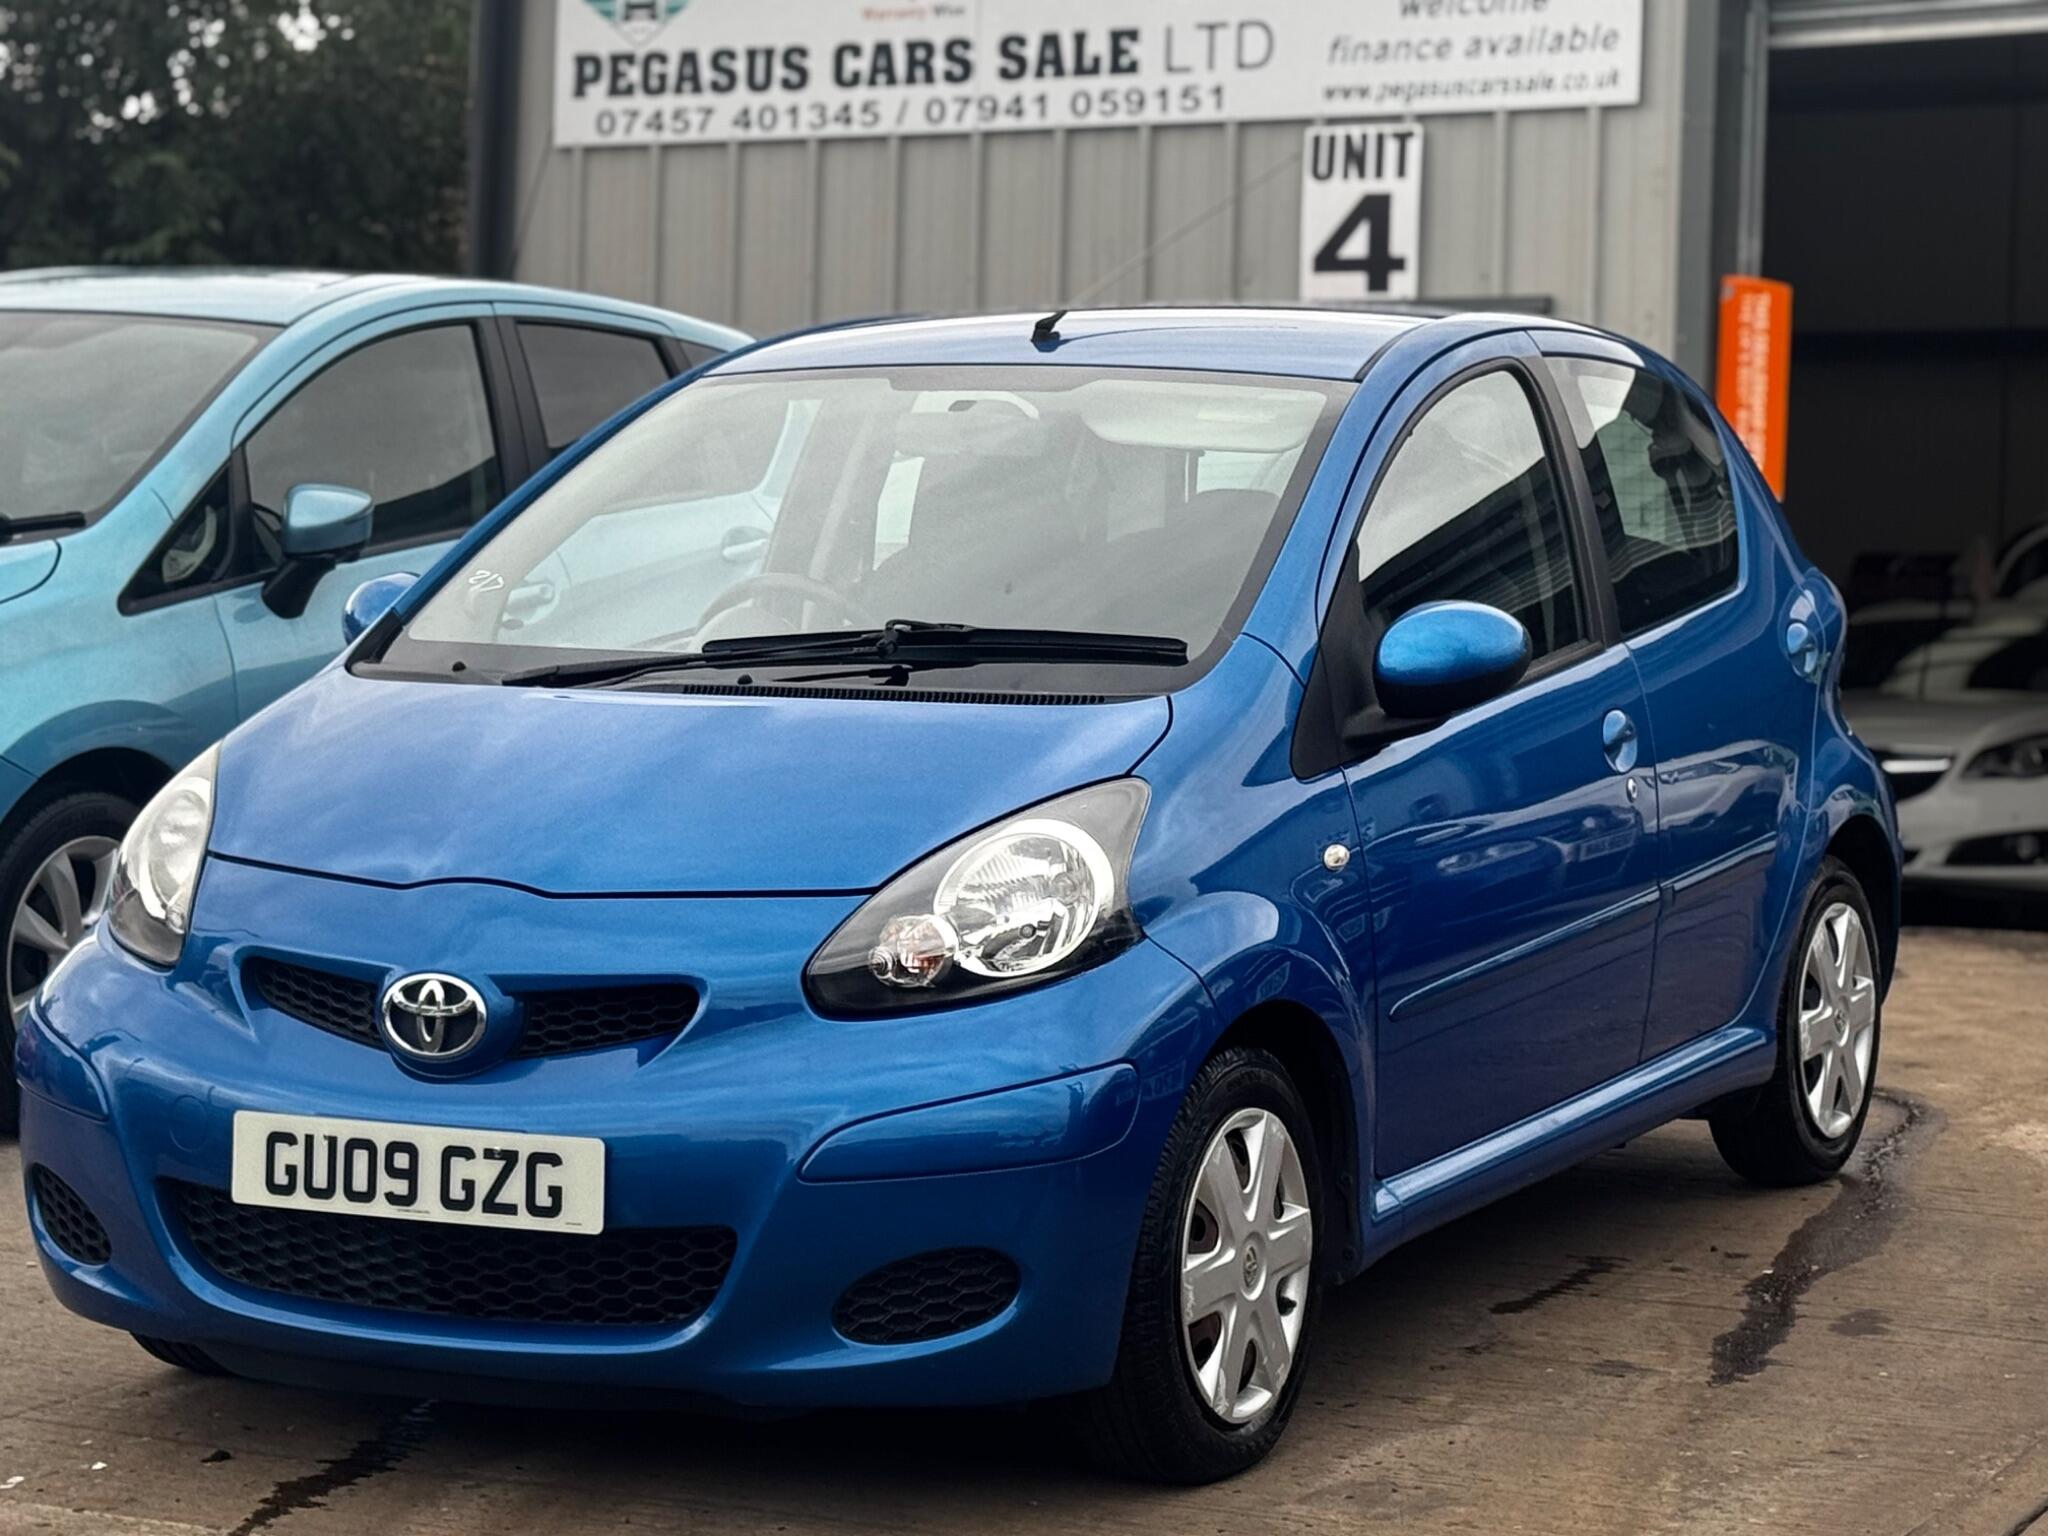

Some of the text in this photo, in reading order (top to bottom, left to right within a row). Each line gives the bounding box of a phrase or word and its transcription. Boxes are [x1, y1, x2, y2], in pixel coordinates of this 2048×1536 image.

[573, 20, 1274, 98] PEGASUS CARS SALE LTD
[1327, 25, 1620, 64] finance available
[596, 107, 715, 138] 07457
[732, 99, 881, 132] 401345
[925, 93, 1051, 125] 07941
[1071, 84, 1226, 118] 059151
[1310, 131, 1414, 180] UNIT
[1313, 193, 1406, 293] 4
[265, 1131, 563, 1218] GU09 GZG
